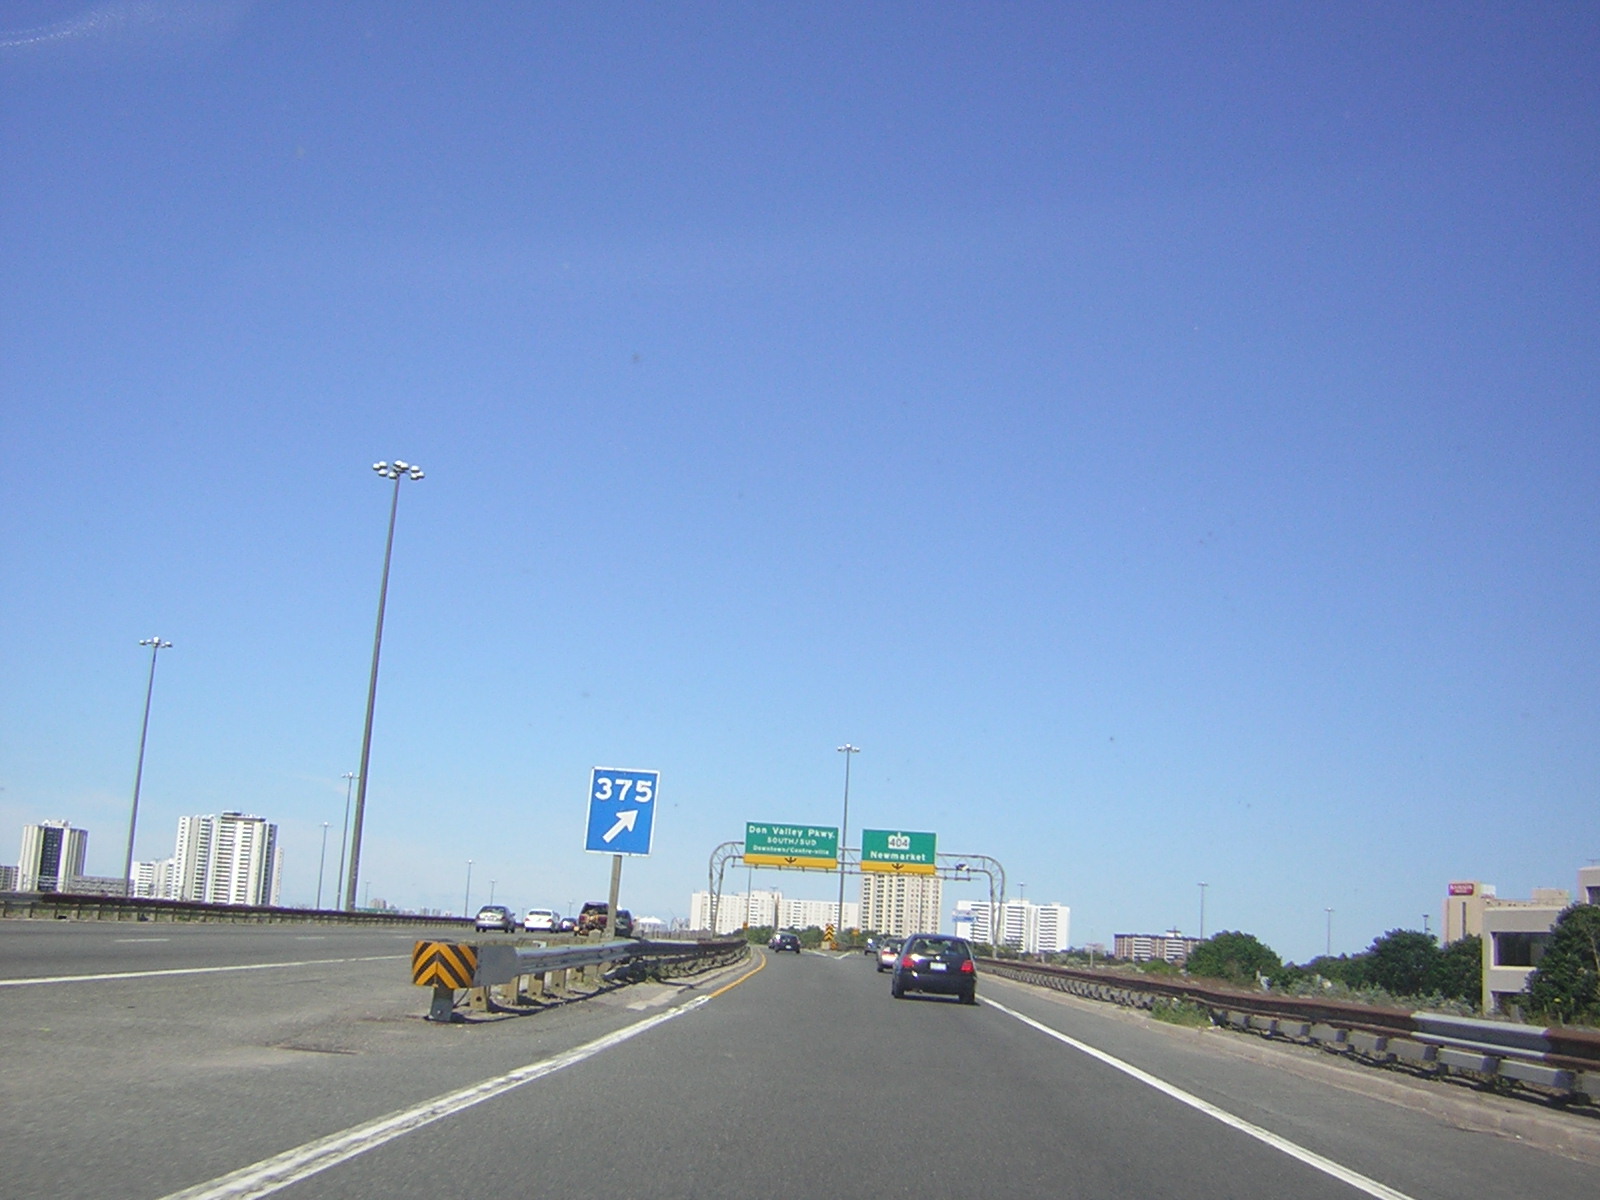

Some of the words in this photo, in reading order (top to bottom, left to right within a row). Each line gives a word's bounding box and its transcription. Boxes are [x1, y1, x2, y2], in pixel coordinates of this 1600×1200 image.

[595, 777, 653, 803] 375
[748, 825, 768, 834] Don
[772, 826, 803, 838] Valley
[889, 838, 908, 847] 404
[870, 850, 926, 861] Newmarket
